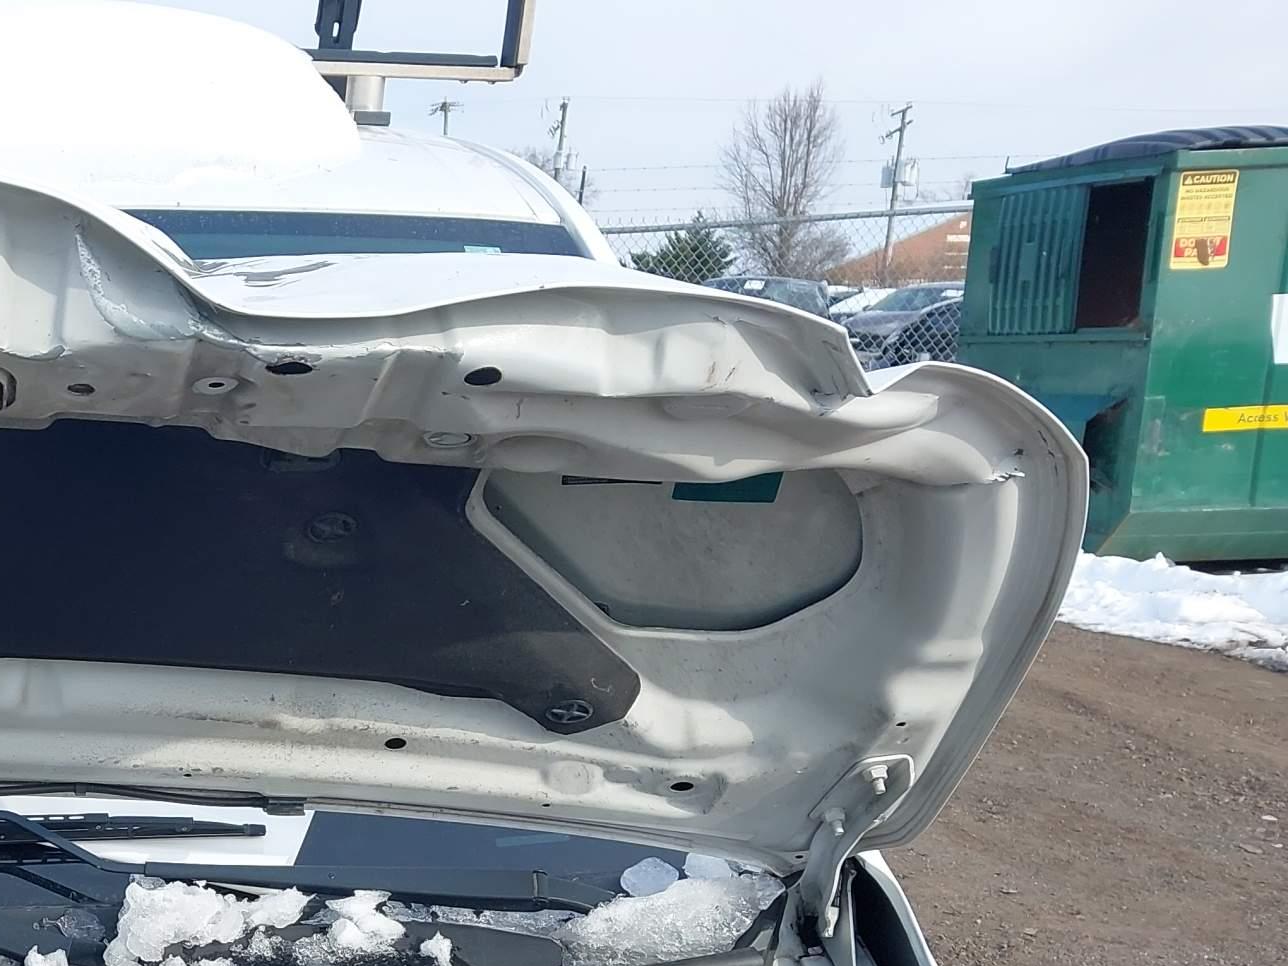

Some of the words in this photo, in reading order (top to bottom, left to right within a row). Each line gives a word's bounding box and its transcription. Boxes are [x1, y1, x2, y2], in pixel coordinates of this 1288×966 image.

[1193, 174, 1234, 184] CAUTION
[1179, 238, 1195, 248] DO
[1238, 413, 1279, 423] Access
